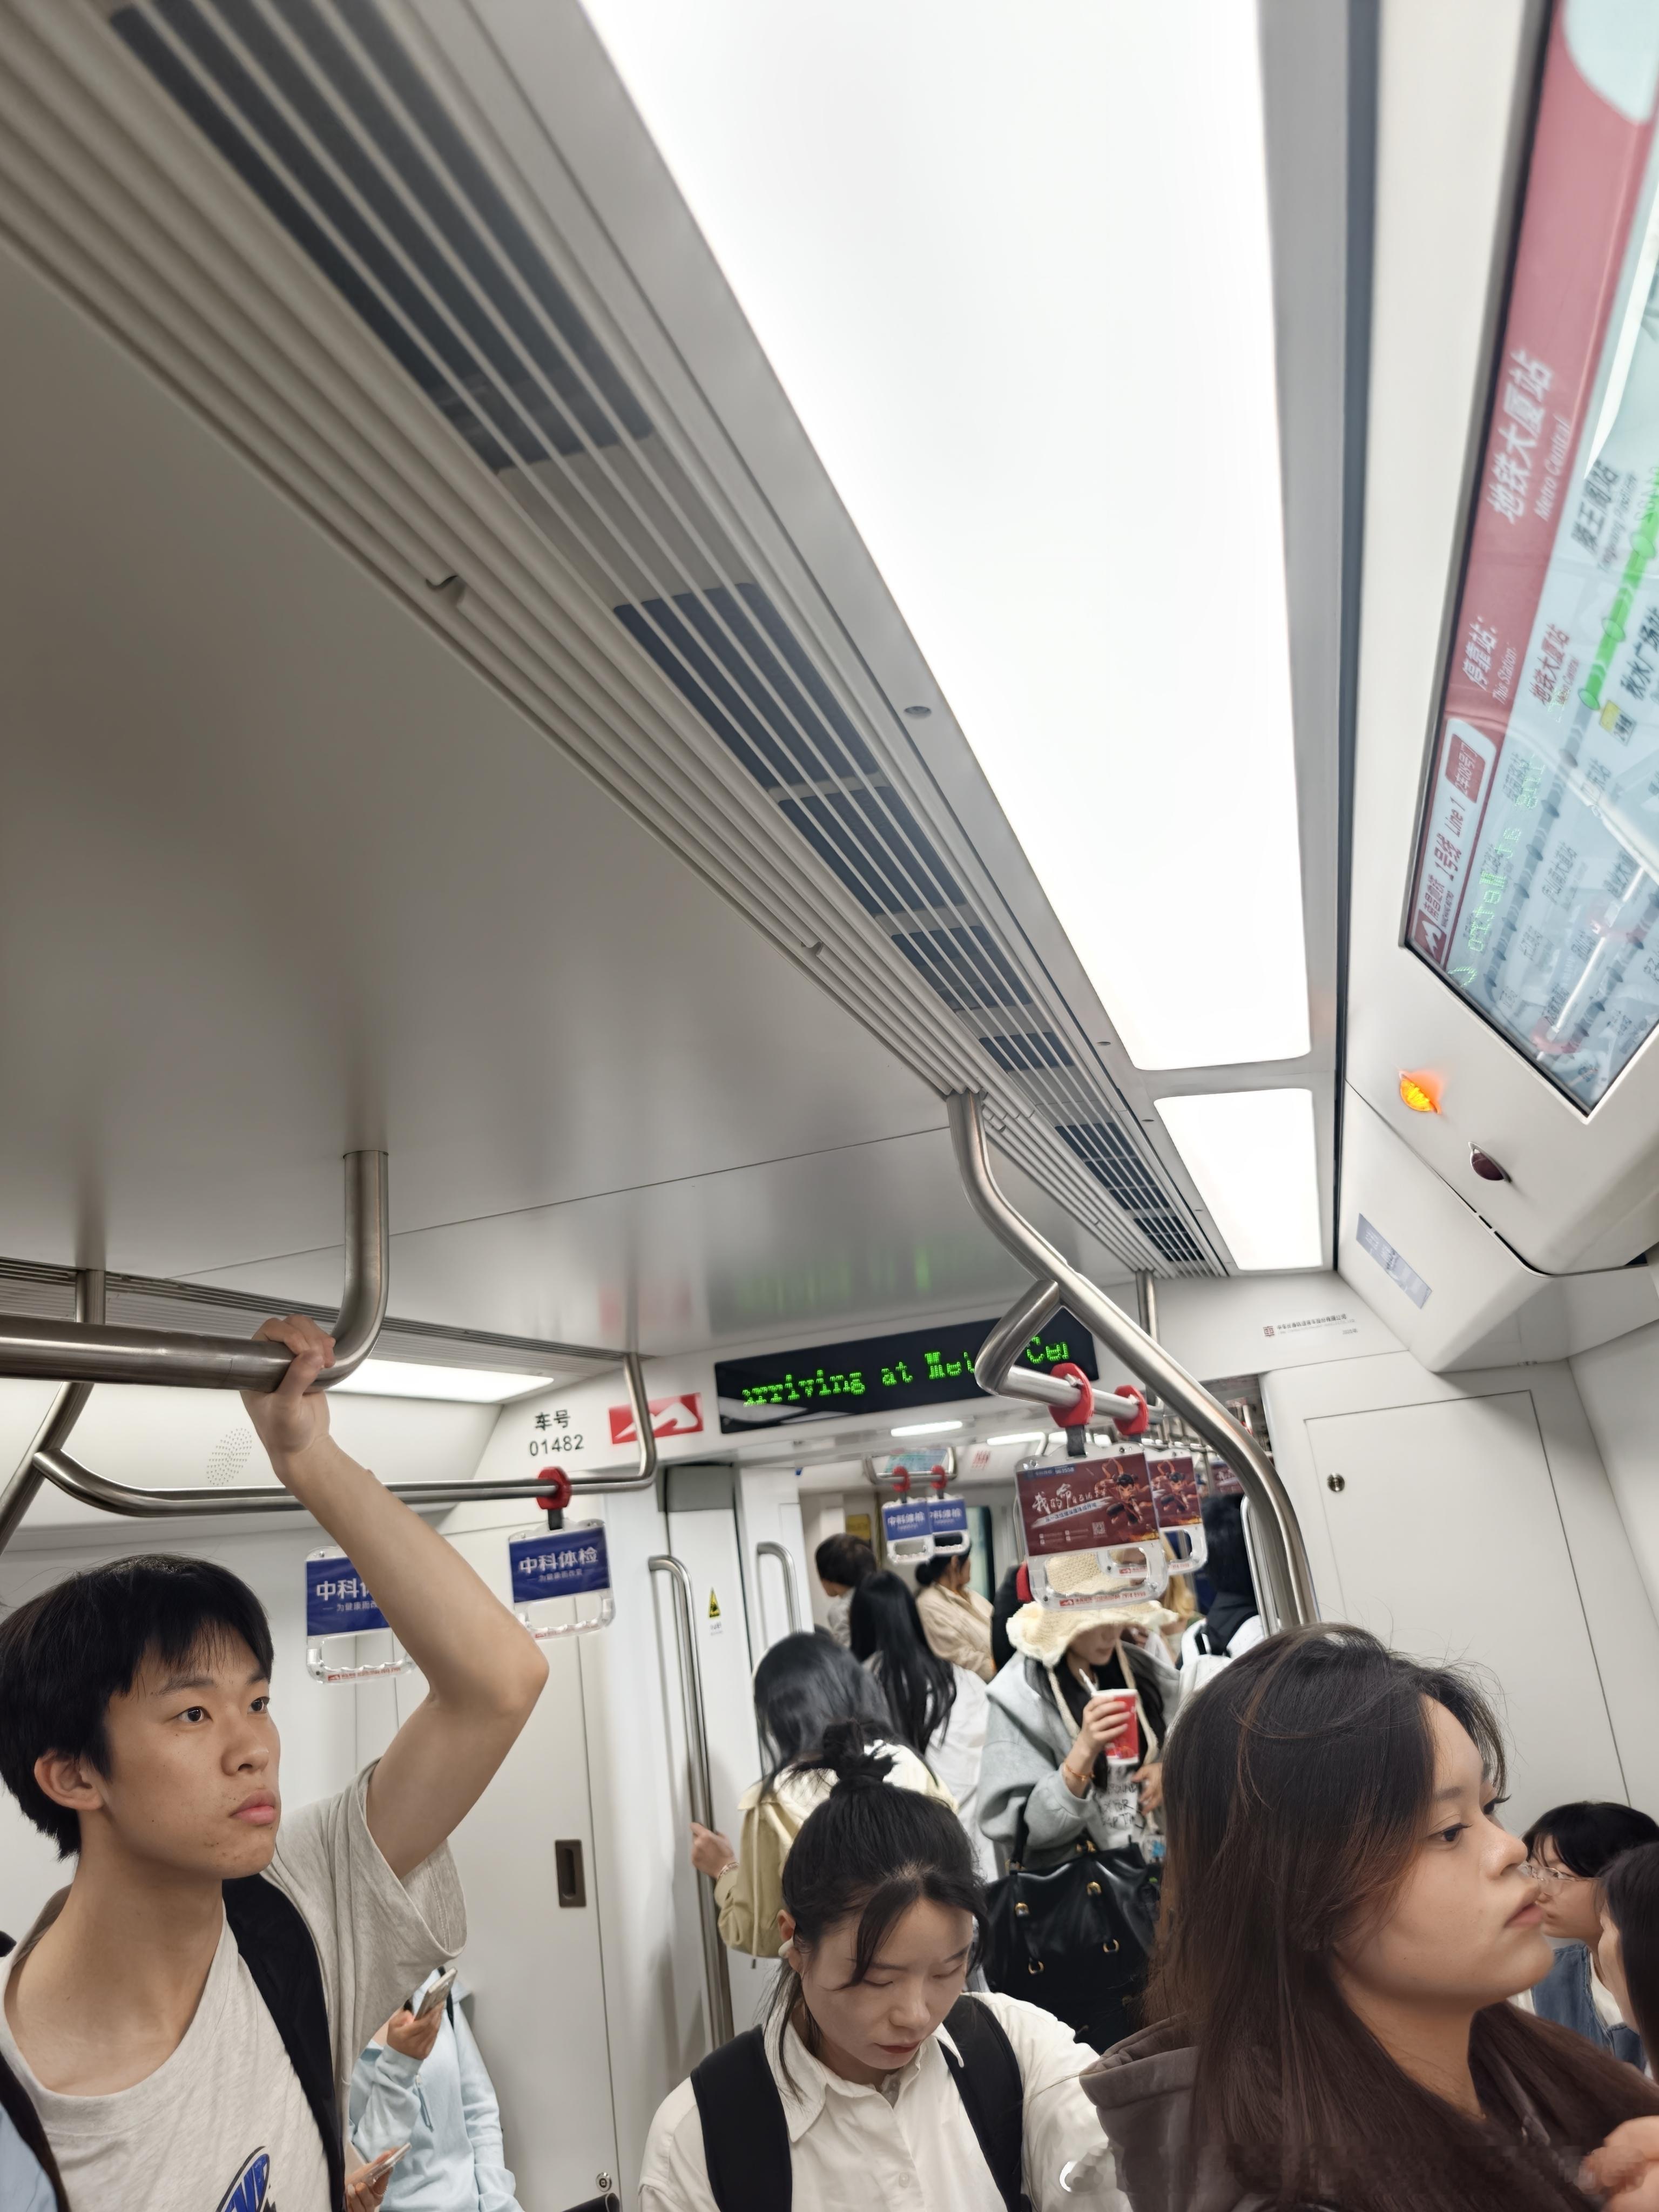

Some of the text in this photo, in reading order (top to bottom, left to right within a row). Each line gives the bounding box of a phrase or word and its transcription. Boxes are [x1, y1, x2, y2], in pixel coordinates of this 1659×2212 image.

[1487, 348, 1554, 525] 地铁大厦站
[1534, 413, 1572, 523] Metro Central
[1529, 623, 1570, 706] 地铁大厦站
[1492, 683, 1509, 705] This
[1444, 795, 1466, 838] Line 1
[1434, 832, 1462, 882] 1号线
[1423, 874, 1445, 921] 南昌地铁
[881, 1361, 913, 1387] at
[534, 1408, 571, 1431] 车号
[529, 1433, 584, 1457] 01482
[518, 1546, 598, 1574] 中科体检
